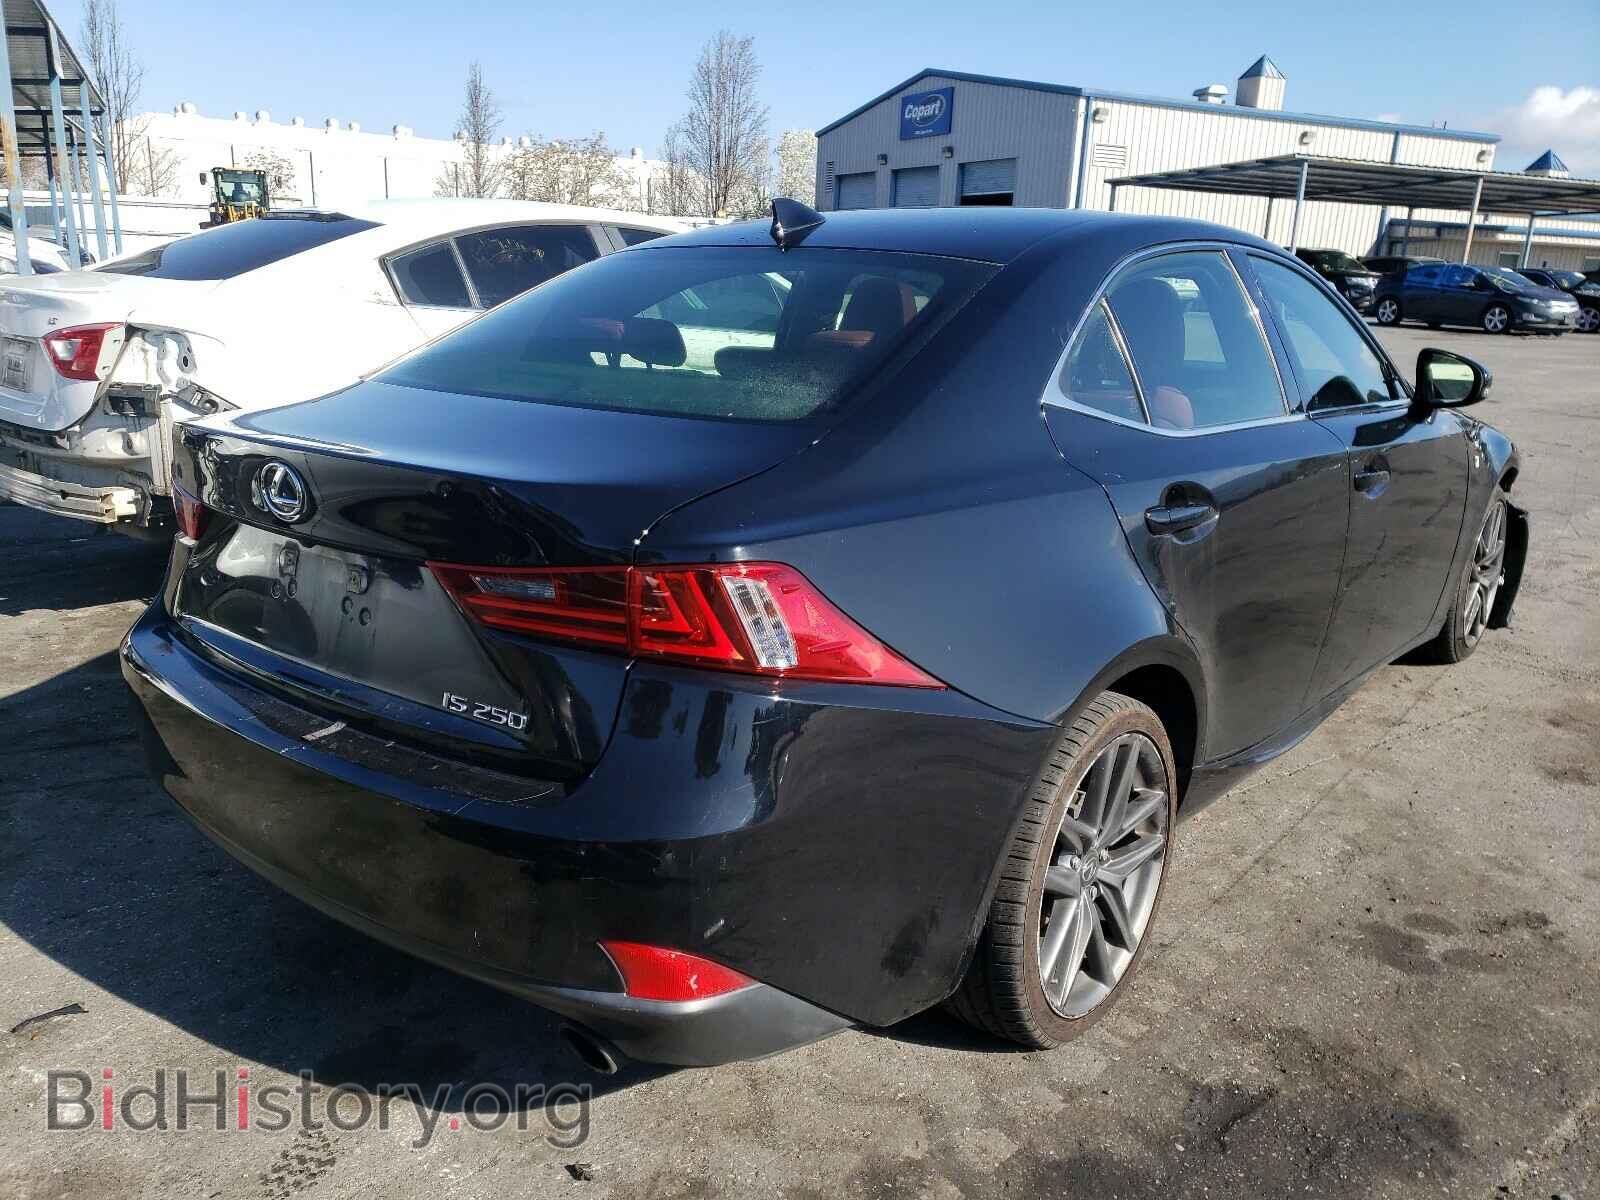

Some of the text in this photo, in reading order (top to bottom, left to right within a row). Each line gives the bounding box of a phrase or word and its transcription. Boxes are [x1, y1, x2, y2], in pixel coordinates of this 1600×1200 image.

[904, 101, 940, 120] Copart
[442, 691, 527, 730] IS 250
